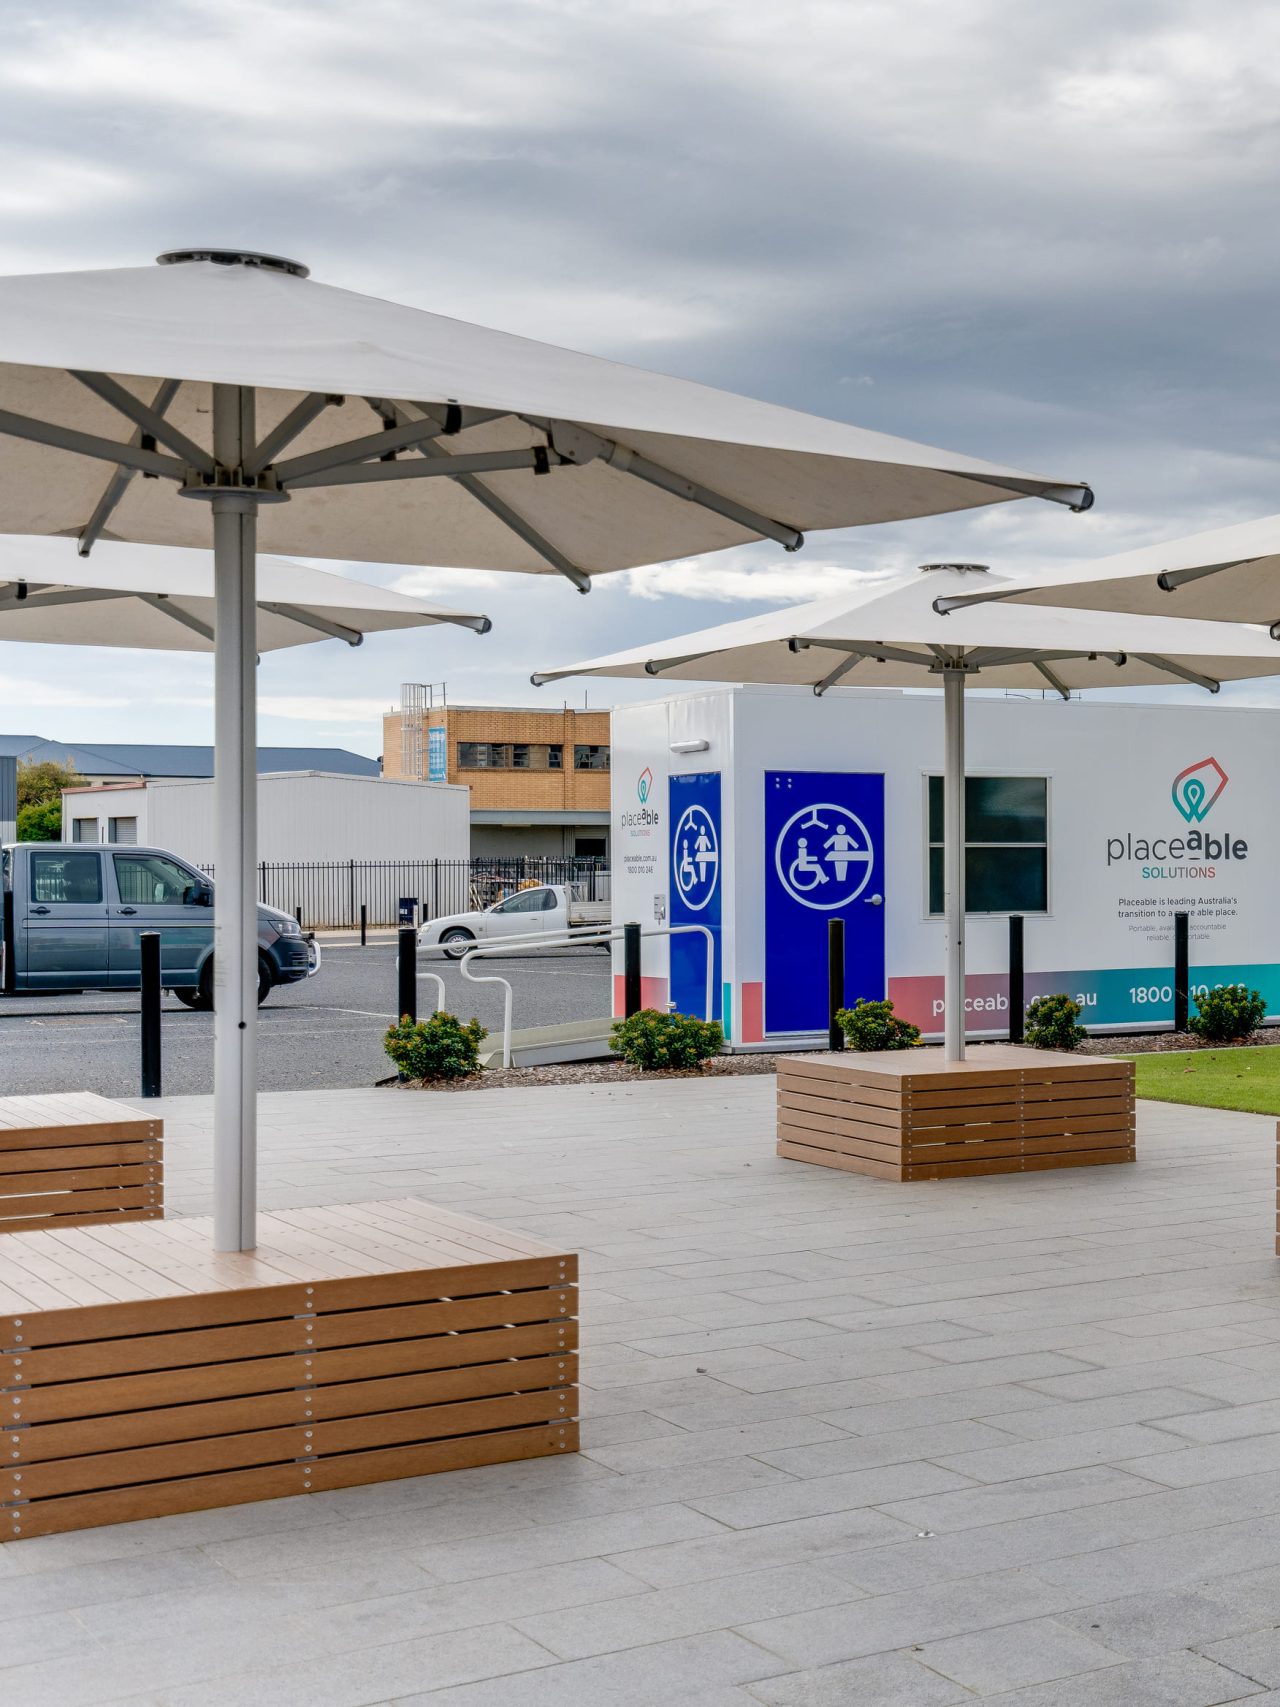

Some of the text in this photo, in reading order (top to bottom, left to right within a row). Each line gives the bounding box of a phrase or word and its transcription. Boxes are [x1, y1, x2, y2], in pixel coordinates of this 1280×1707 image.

[621, 808, 659, 829] placeable
[1107, 830, 1248, 866] placeable
[1142, 867, 1216, 878] SOLUTIONS
[1118, 898, 1157, 906] Placeable
[1167, 897, 1196, 907] leading
[1198, 897, 1238, 905] Australia's
[1118, 909, 1155, 918] transition
[1197, 908, 1214, 916] able
[1215, 908, 1238, 918] place.
[1129, 986, 1172, 1004] 1800
